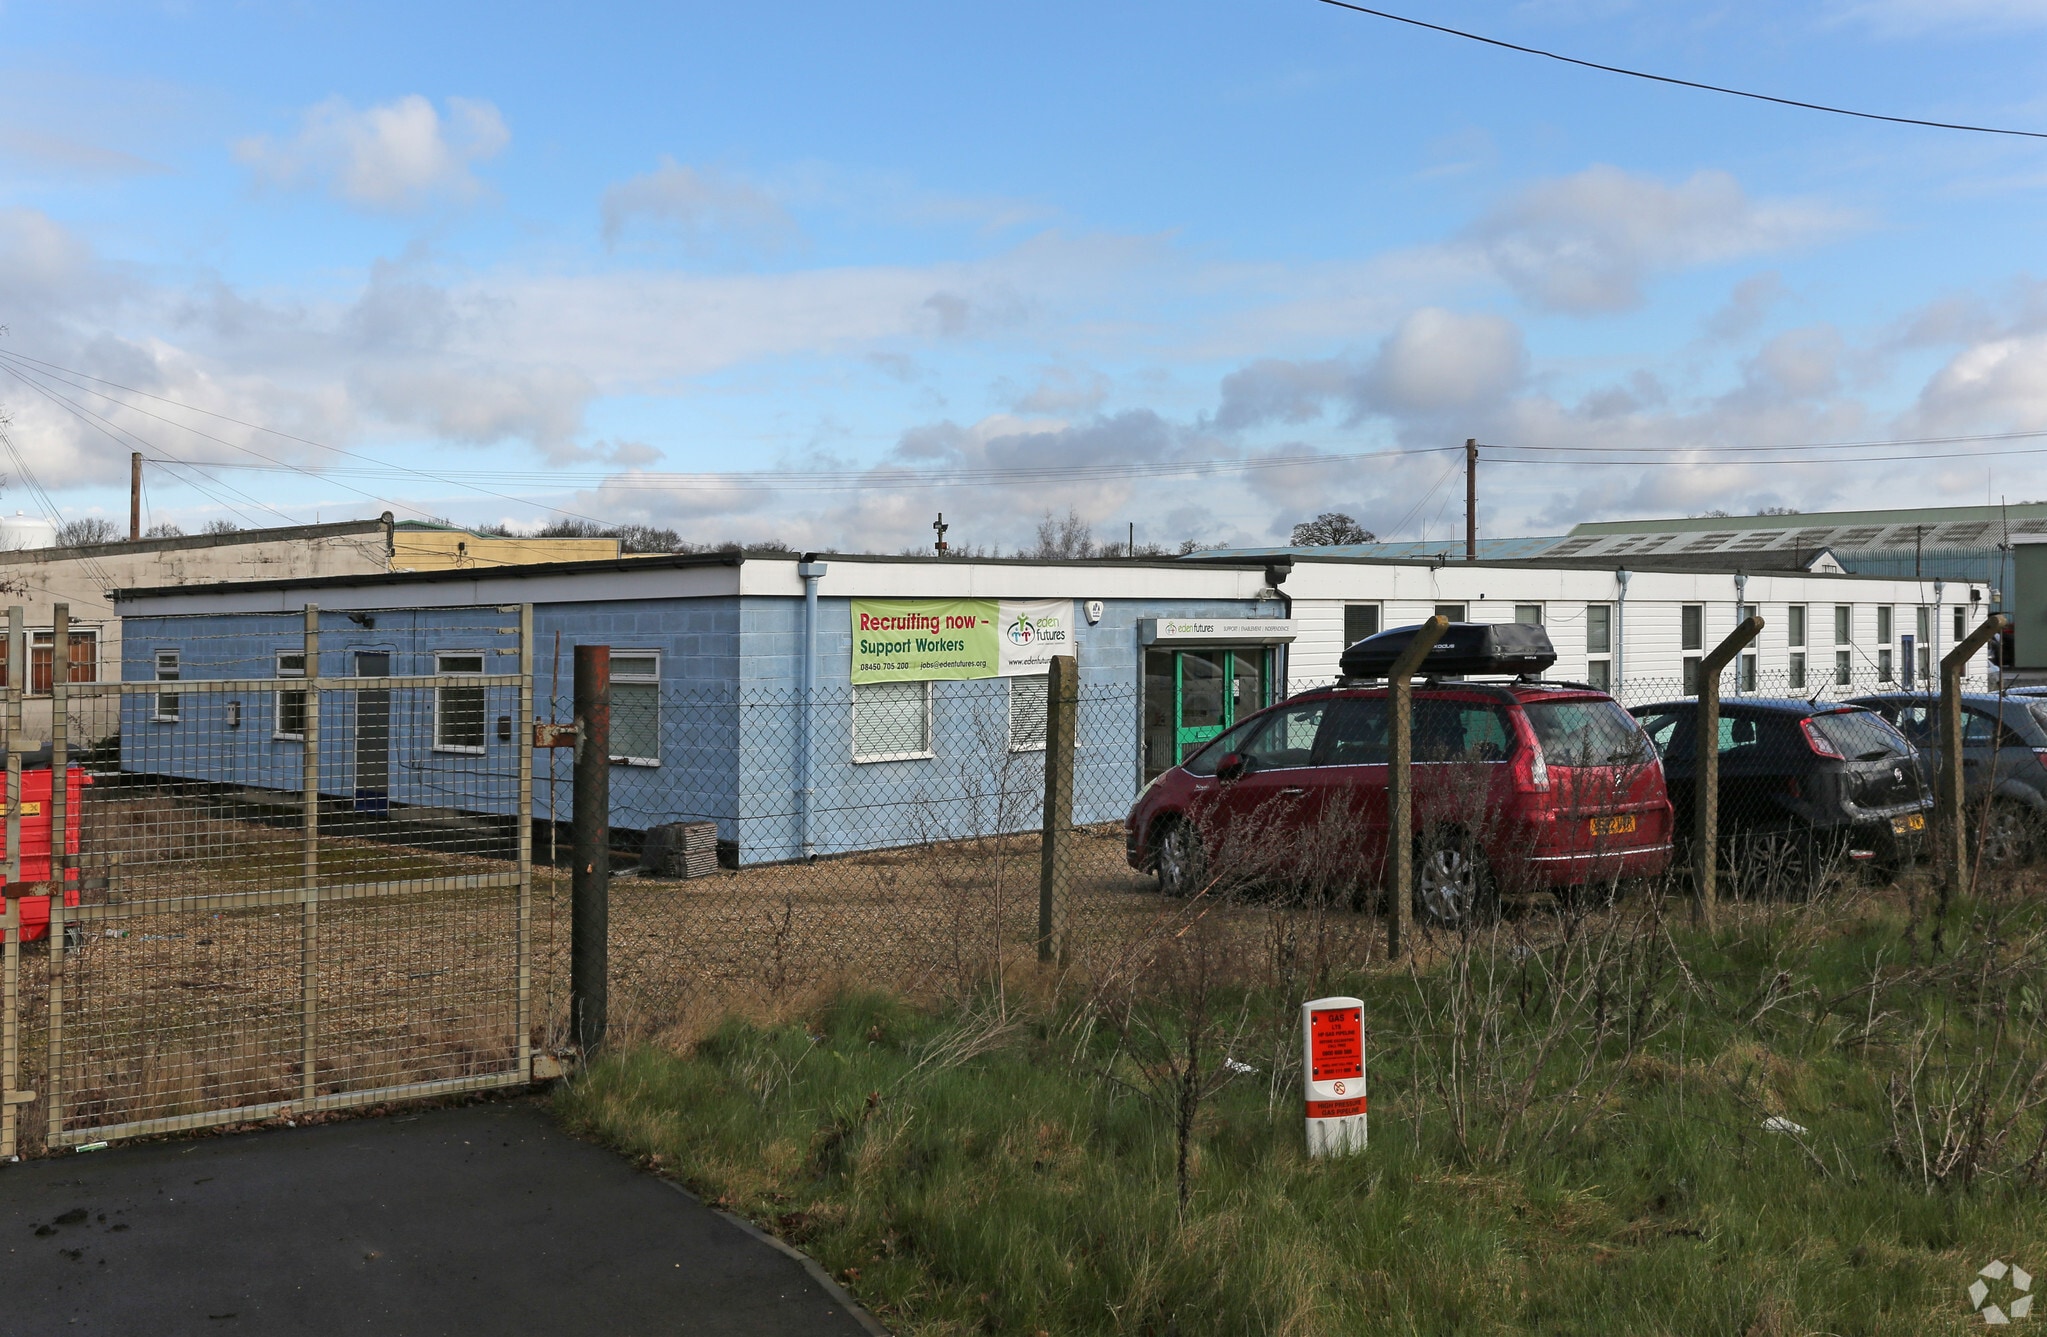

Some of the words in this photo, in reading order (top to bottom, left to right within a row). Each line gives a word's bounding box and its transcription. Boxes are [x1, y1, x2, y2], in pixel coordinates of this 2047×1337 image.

[860, 613, 940, 635] Recruiting
[946, 615, 976, 629] now
[1036, 616, 1060, 628] eden
[1036, 628, 1066, 641] futures
[860, 639, 911, 657] Support
[916, 638, 964, 653] Workers
[860, 663, 881, 671] 08450
[883, 662, 895, 670] 705
[897, 662, 909, 670] 200
[920, 660, 987, 671] jobs@edenfutures.org
[1328, 1014, 1344, 1022] GAS
